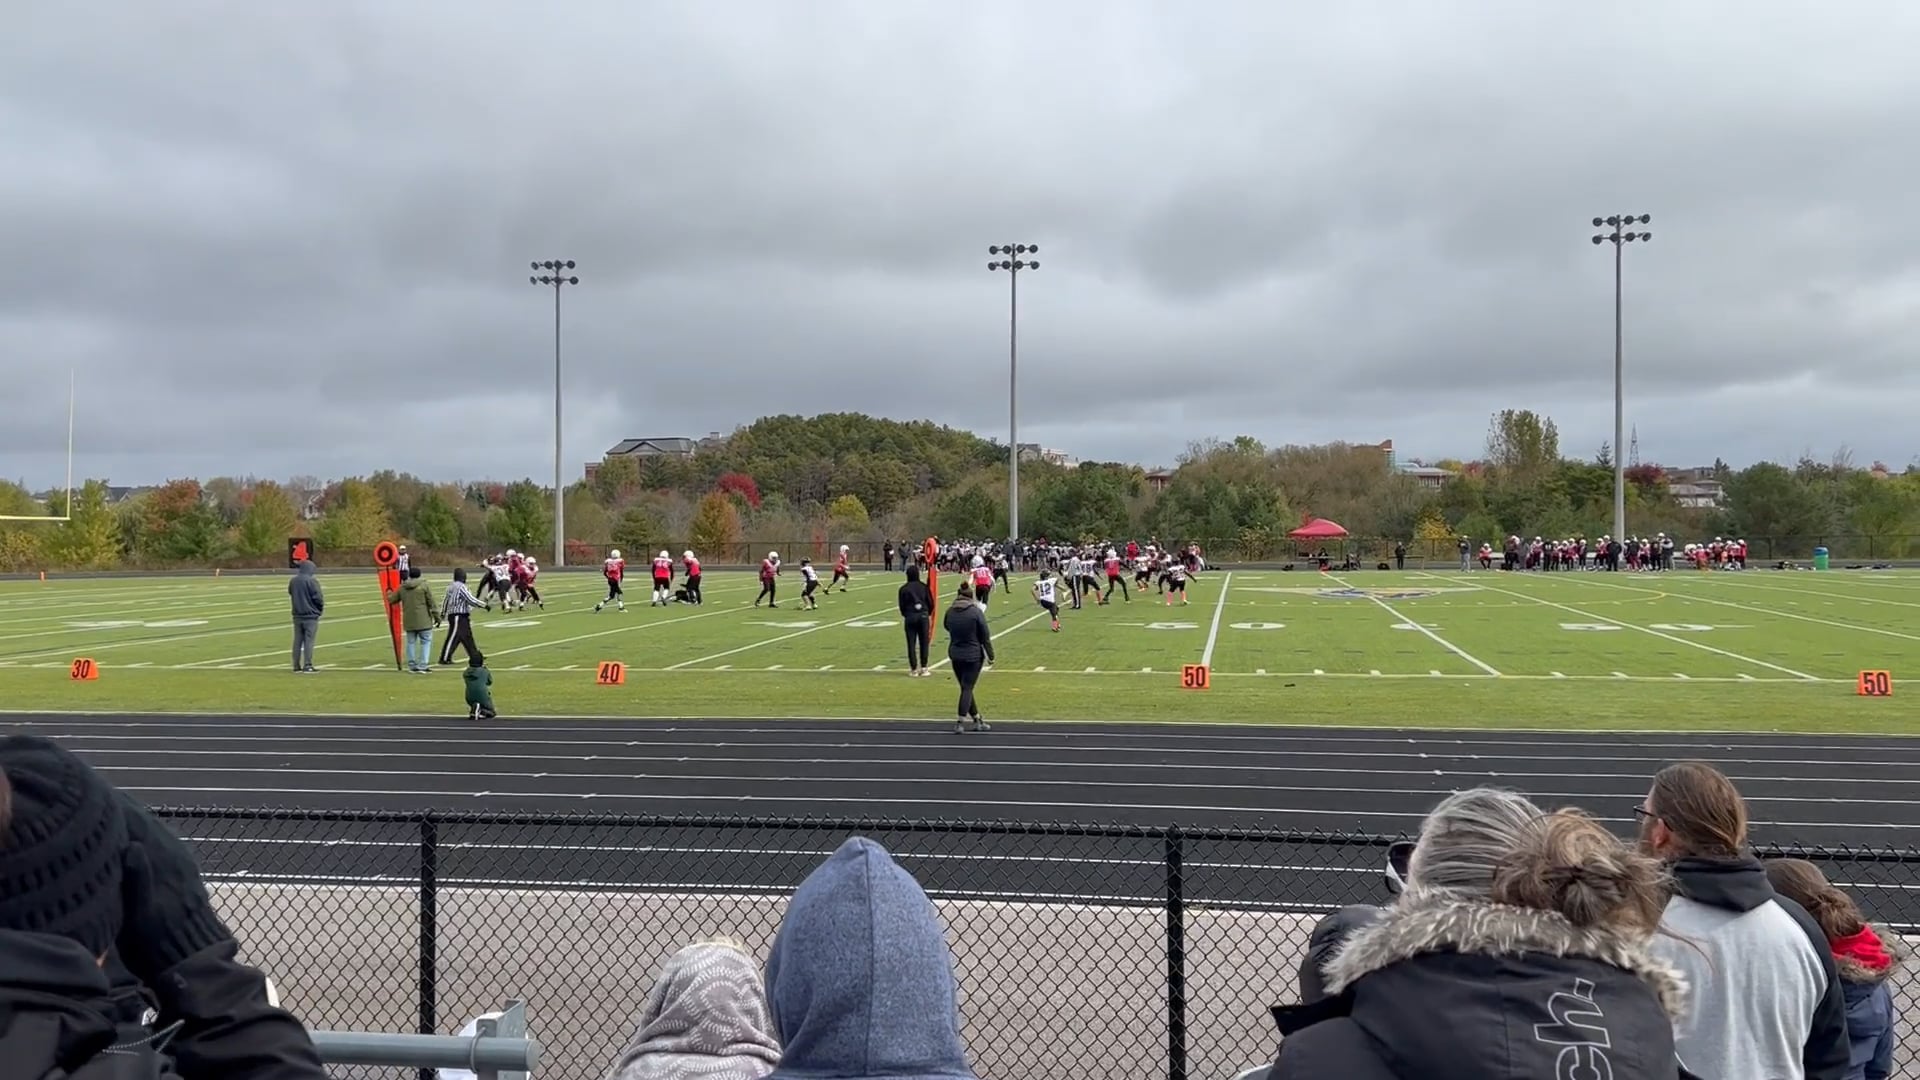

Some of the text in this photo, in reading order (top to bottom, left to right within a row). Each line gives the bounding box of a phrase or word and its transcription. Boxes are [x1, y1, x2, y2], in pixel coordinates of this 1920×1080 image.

[1040, 583, 1052, 597] 12
[71, 659, 91, 679] 30
[600, 663, 620, 683] 40
[1184, 666, 1205, 687] 50
[1863, 671, 1888, 696] 50
